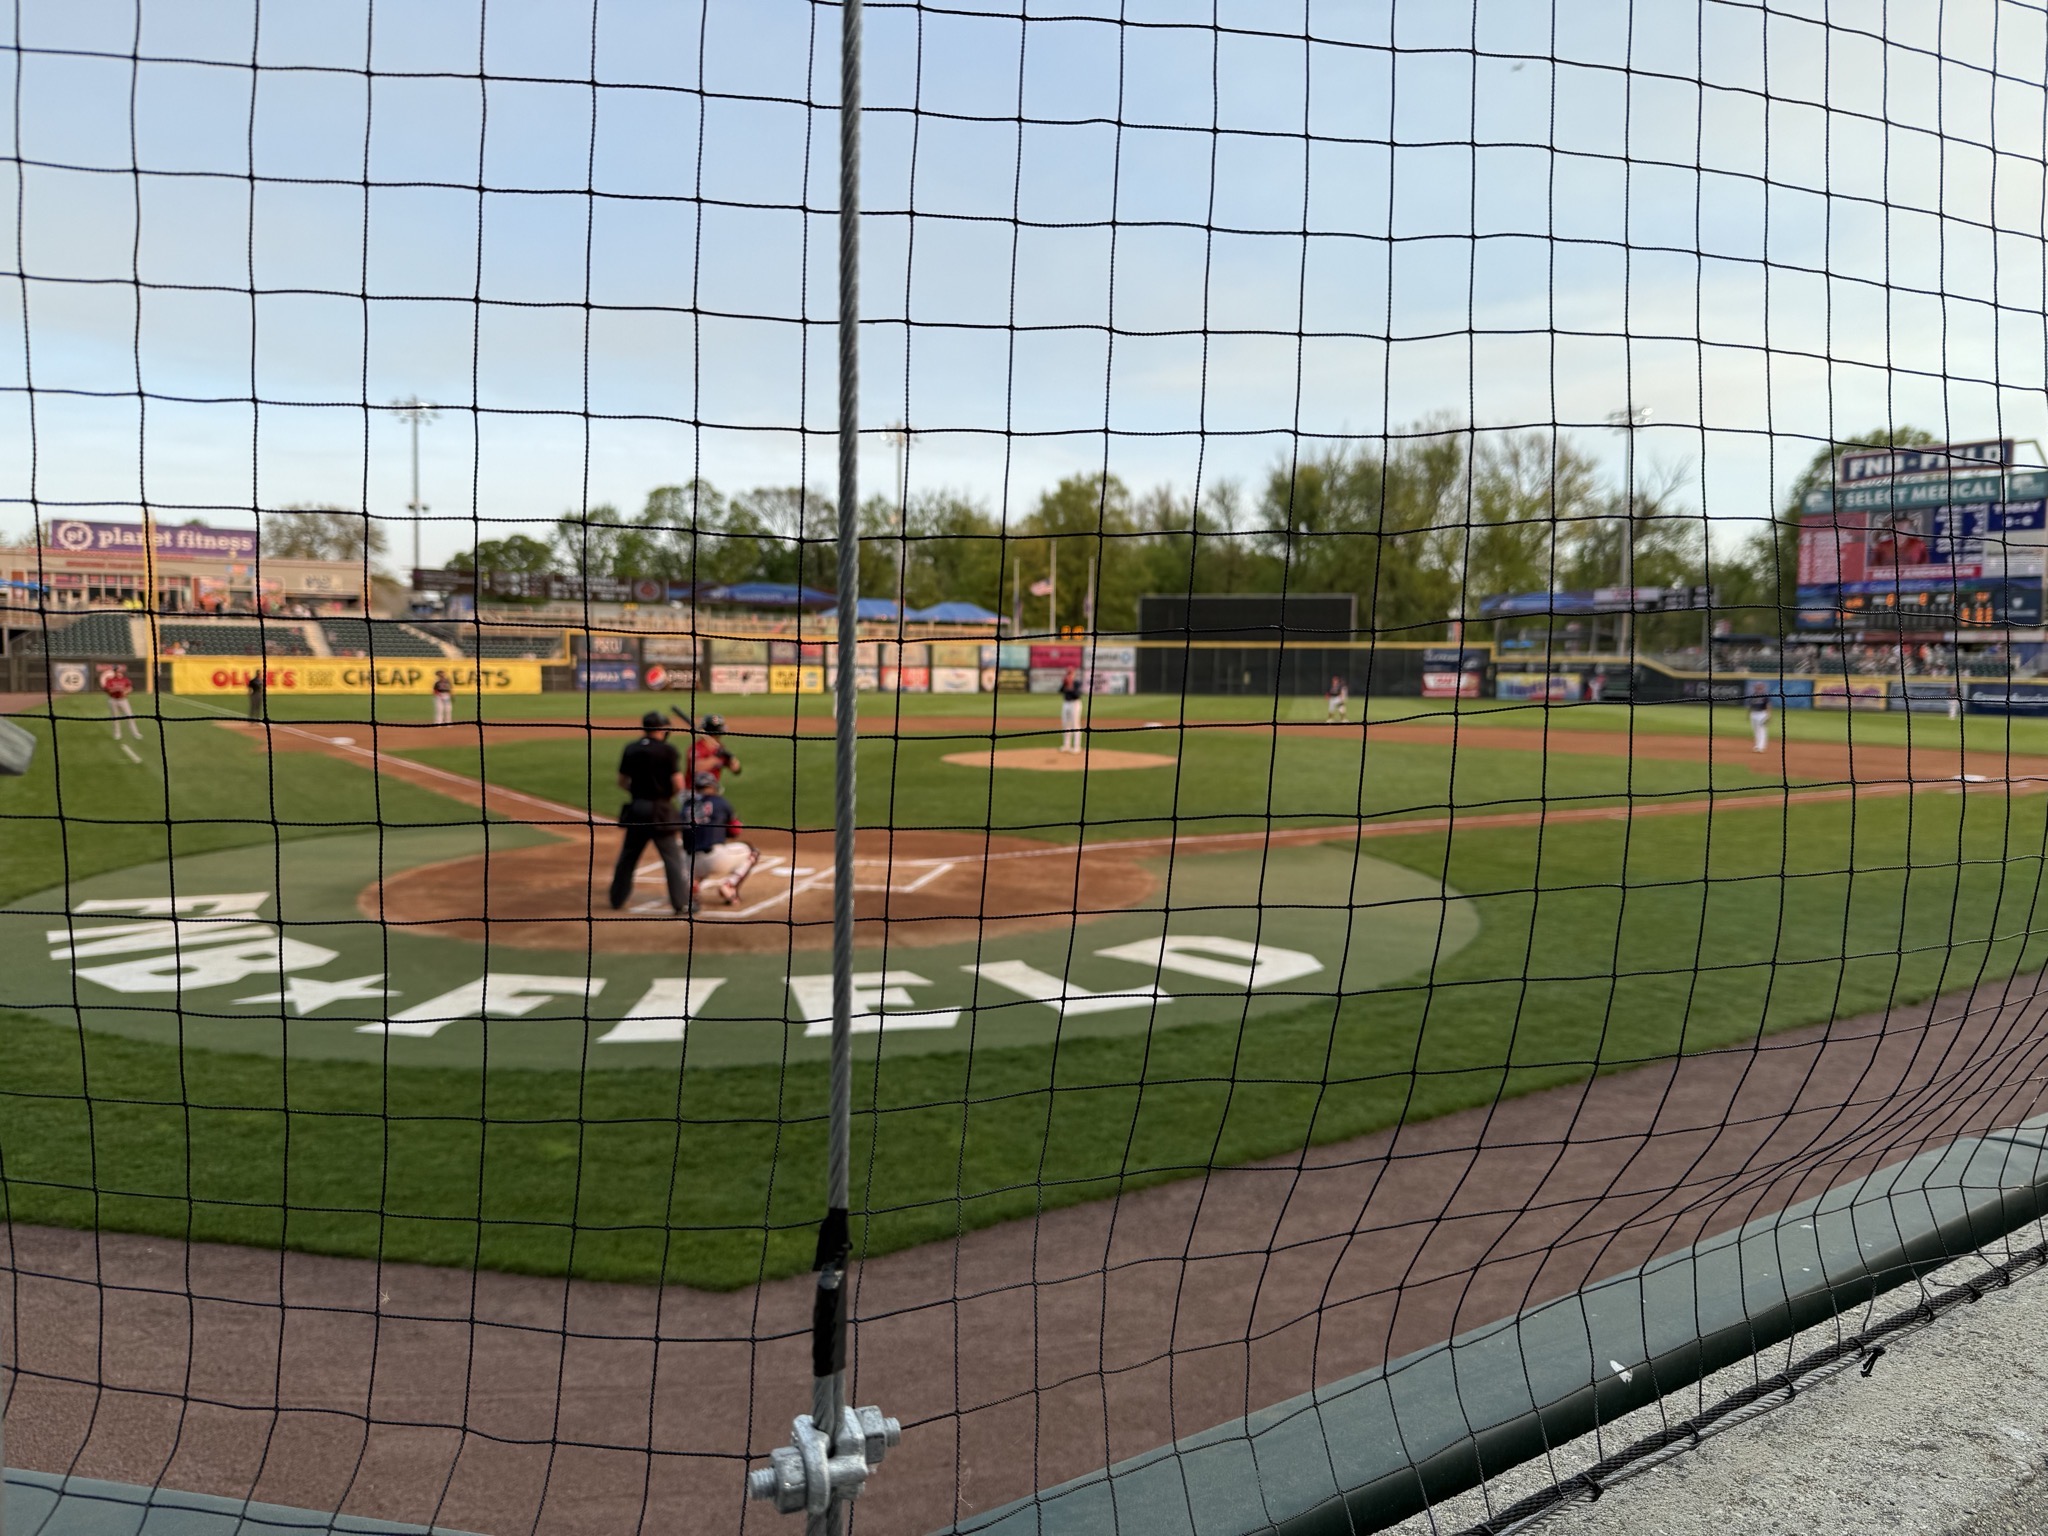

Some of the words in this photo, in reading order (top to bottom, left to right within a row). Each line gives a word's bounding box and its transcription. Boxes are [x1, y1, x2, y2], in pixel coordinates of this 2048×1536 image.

[1849, 455, 1905, 480] FNB
[1919, 444, 2003, 470] FIELD
[1844, 488, 1908, 508] SELECT
[1911, 480, 1996, 502] MEDICAL
[176, 529, 253, 551] fitness
[343, 669, 421, 687] CHEAP
[46, 891, 340, 995] FNB
[354, 935, 1325, 1044] FIELD
